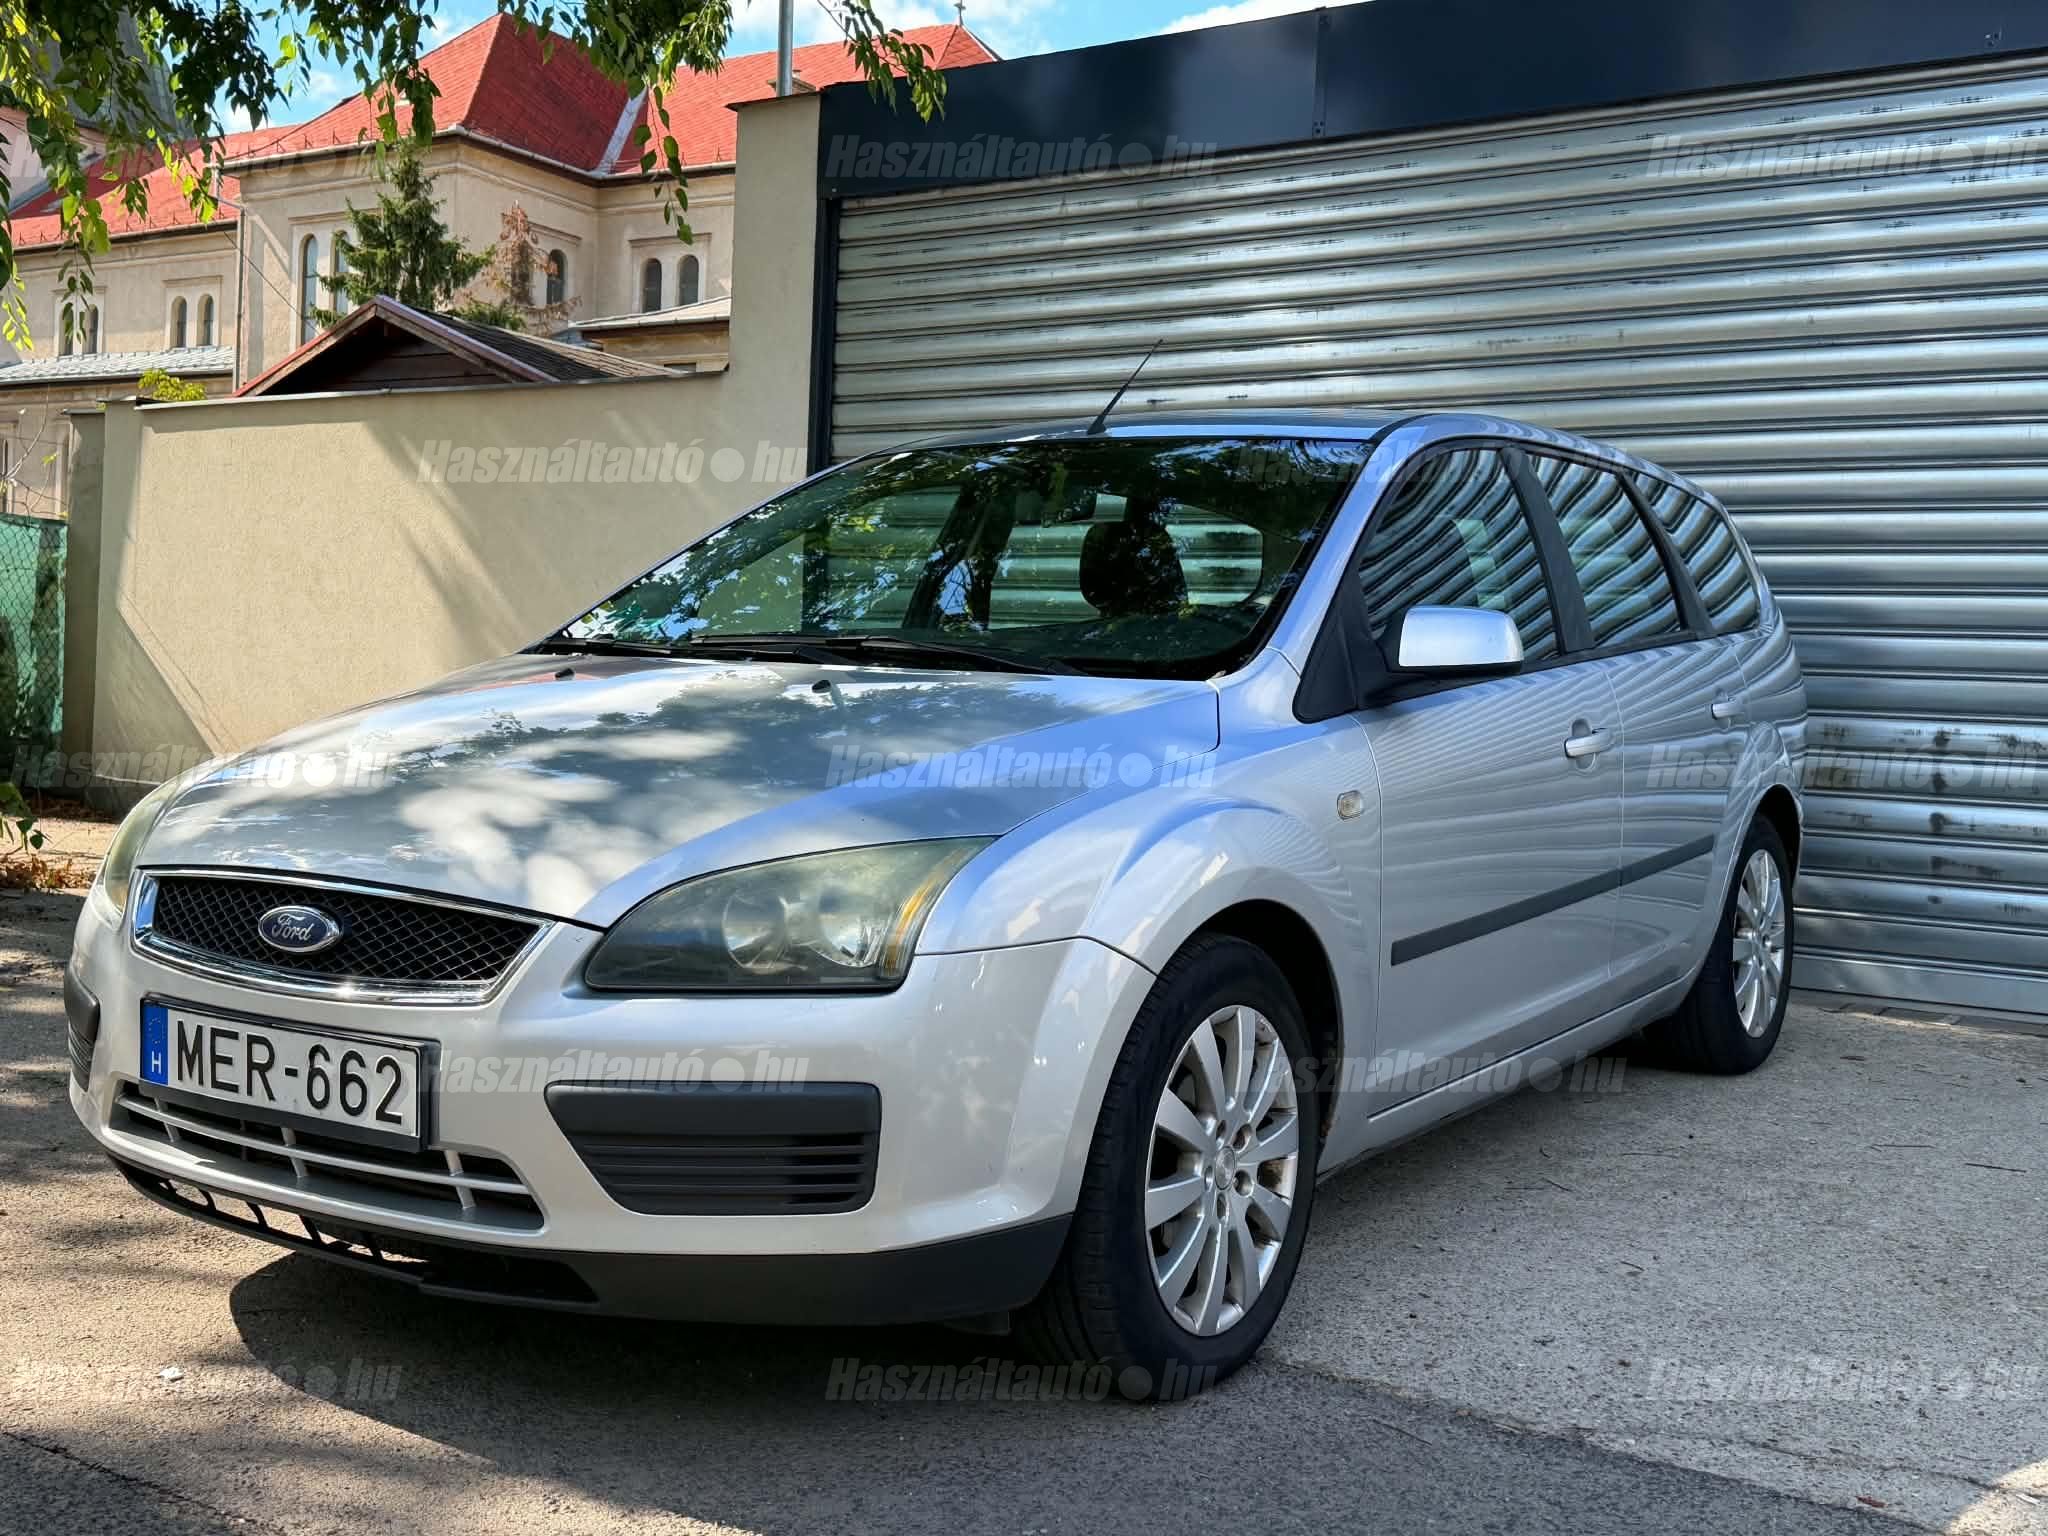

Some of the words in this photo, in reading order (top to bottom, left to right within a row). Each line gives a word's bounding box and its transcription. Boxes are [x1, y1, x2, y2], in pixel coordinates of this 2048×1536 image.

[272, 913, 315, 941] Ford
[151, 1050, 162, 1074] H
[177, 1019, 402, 1125] MER-662
